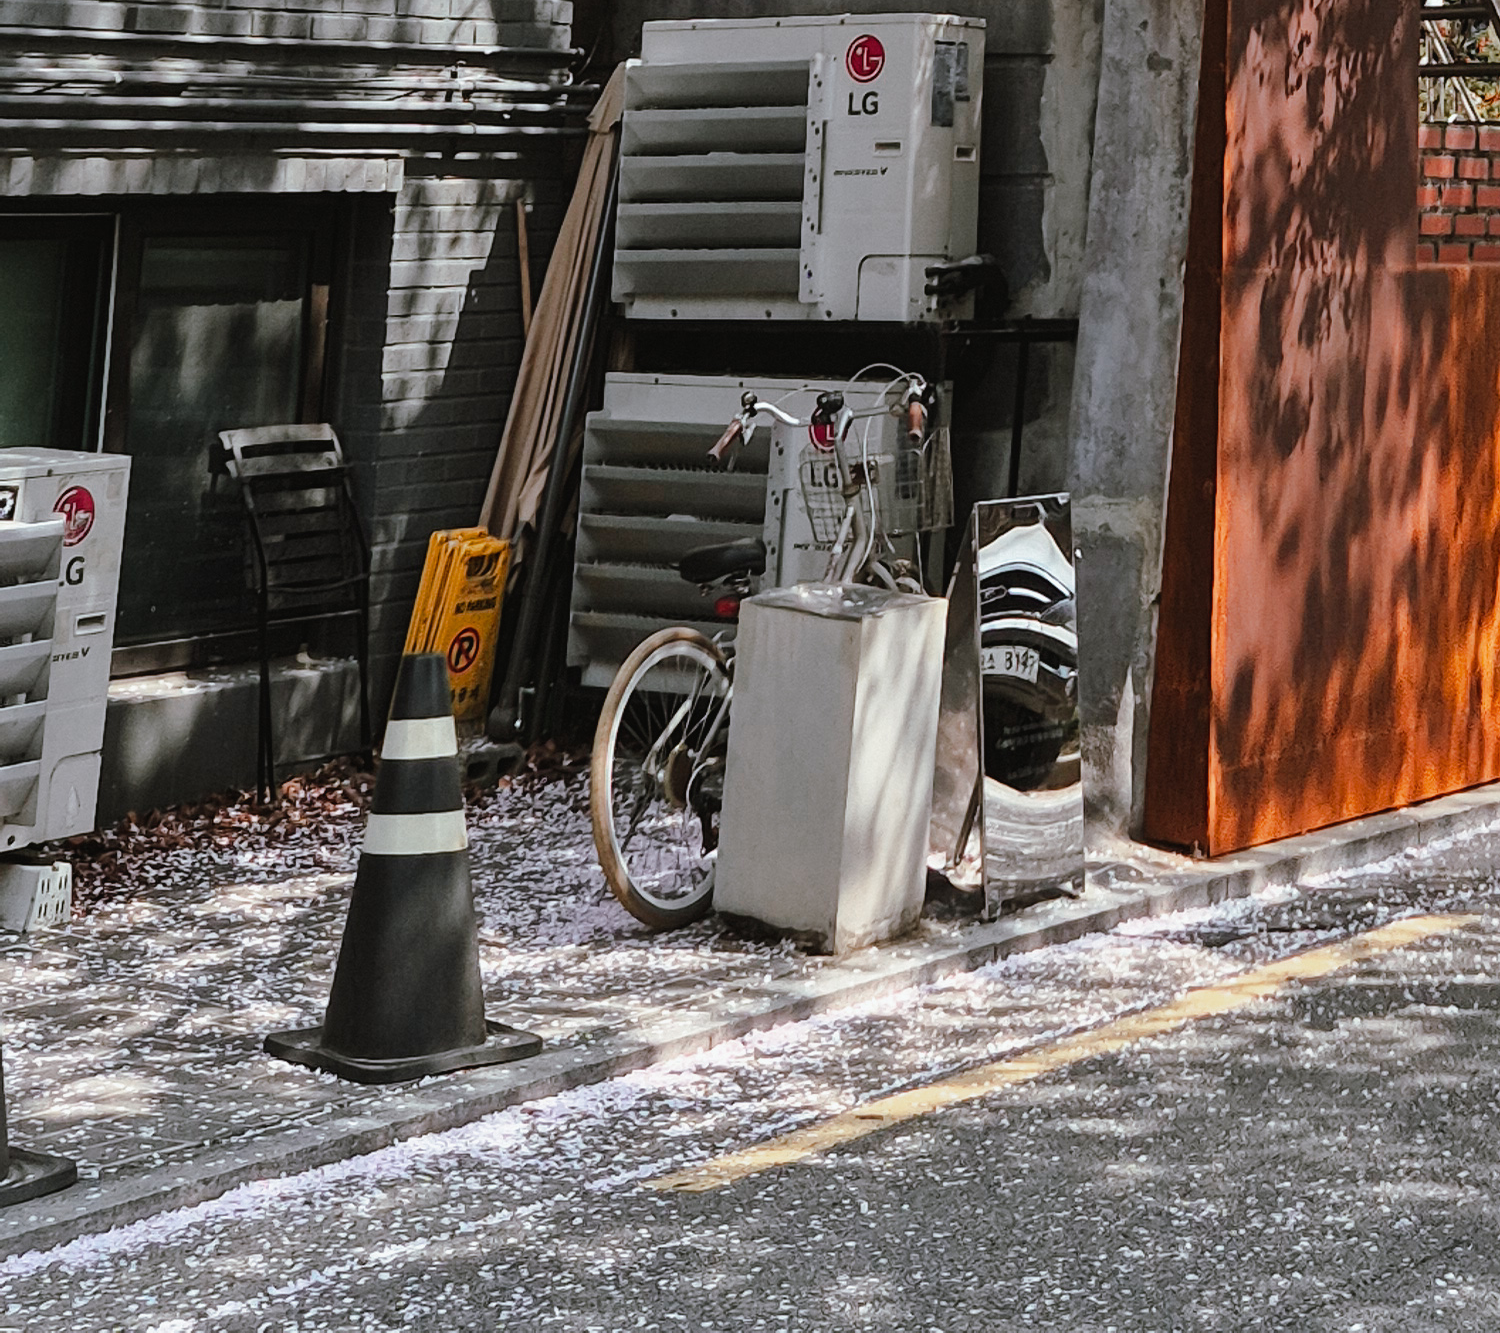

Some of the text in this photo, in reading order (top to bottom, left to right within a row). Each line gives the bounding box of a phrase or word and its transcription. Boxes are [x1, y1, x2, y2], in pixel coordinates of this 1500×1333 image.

[847, 90, 879, 116] LG
[810, 461, 839, 488] LG
[58, 555, 86, 587] G
